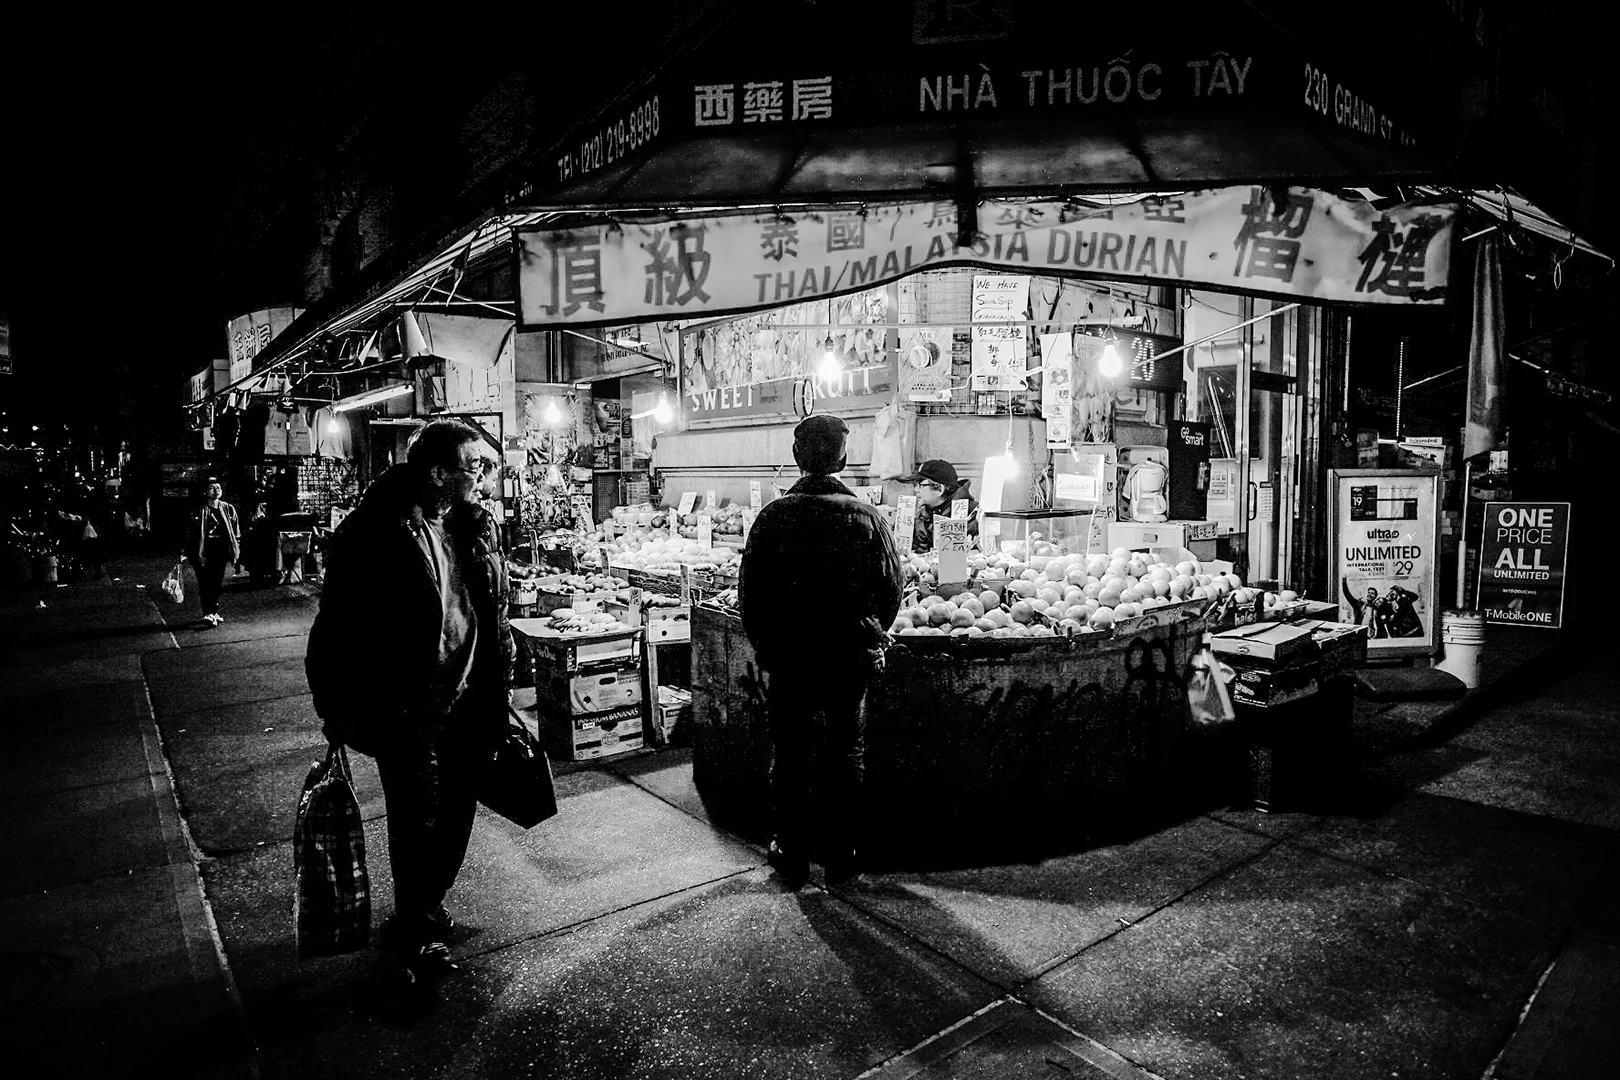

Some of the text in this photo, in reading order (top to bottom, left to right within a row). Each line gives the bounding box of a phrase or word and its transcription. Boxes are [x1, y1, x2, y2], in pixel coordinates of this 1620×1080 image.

[920, 49, 1252, 112] NHÀ THUỐC TÂY
[694, 76, 833, 127] 西藥房
[1304, 62, 1328, 116] 230
[1335, 83, 1376, 136] GRAND
[607, 94, 660, 164] 219-8998
[1047, 229, 1188, 278] DURIAN
[976, 279, 1019, 290] WE HAVE
[1131, 337, 1155, 381] 20
[690, 383, 755, 412] SWEET
[1185, 434, 1205, 447] smart
[1498, 508, 1554, 528] ONE
[1497, 528, 1552, 544] PRICE
[1346, 545, 1421, 561] UNLIMITED
[1494, 548, 1550, 570] ALL
[1494, 570, 1549, 580] UNLIMITED
[609, 707, 639, 721] BANANAS
